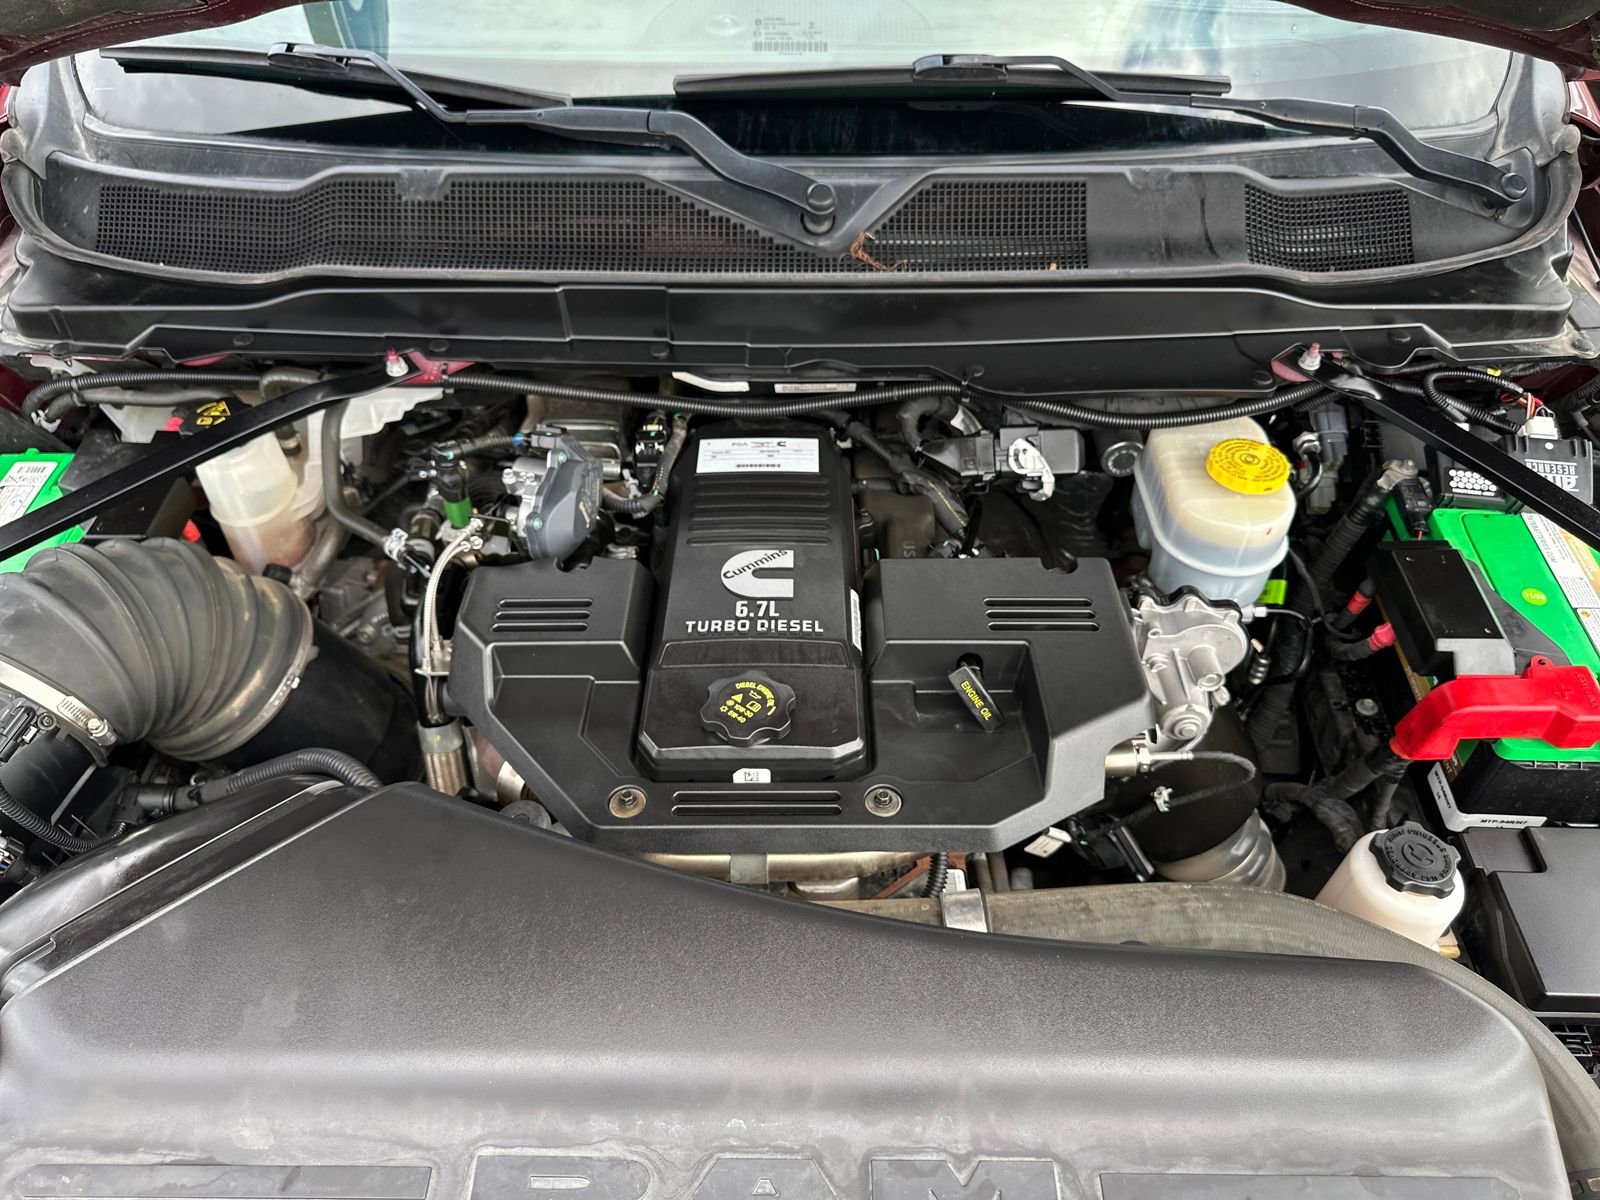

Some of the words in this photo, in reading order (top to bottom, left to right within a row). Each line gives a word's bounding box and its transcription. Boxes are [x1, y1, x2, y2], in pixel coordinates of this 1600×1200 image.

[1526, 462, 1576, 475] RESEARCH
[722, 549, 788, 579] Cummins
[735, 600, 780, 617] 6.7L
[685, 620, 750, 633] TURBO
[756, 619, 824, 633] DIESEL
[735, 681, 757, 690] DIESEL
[960, 680, 985, 709] ENGINE
[980, 707, 992, 721] OIL
